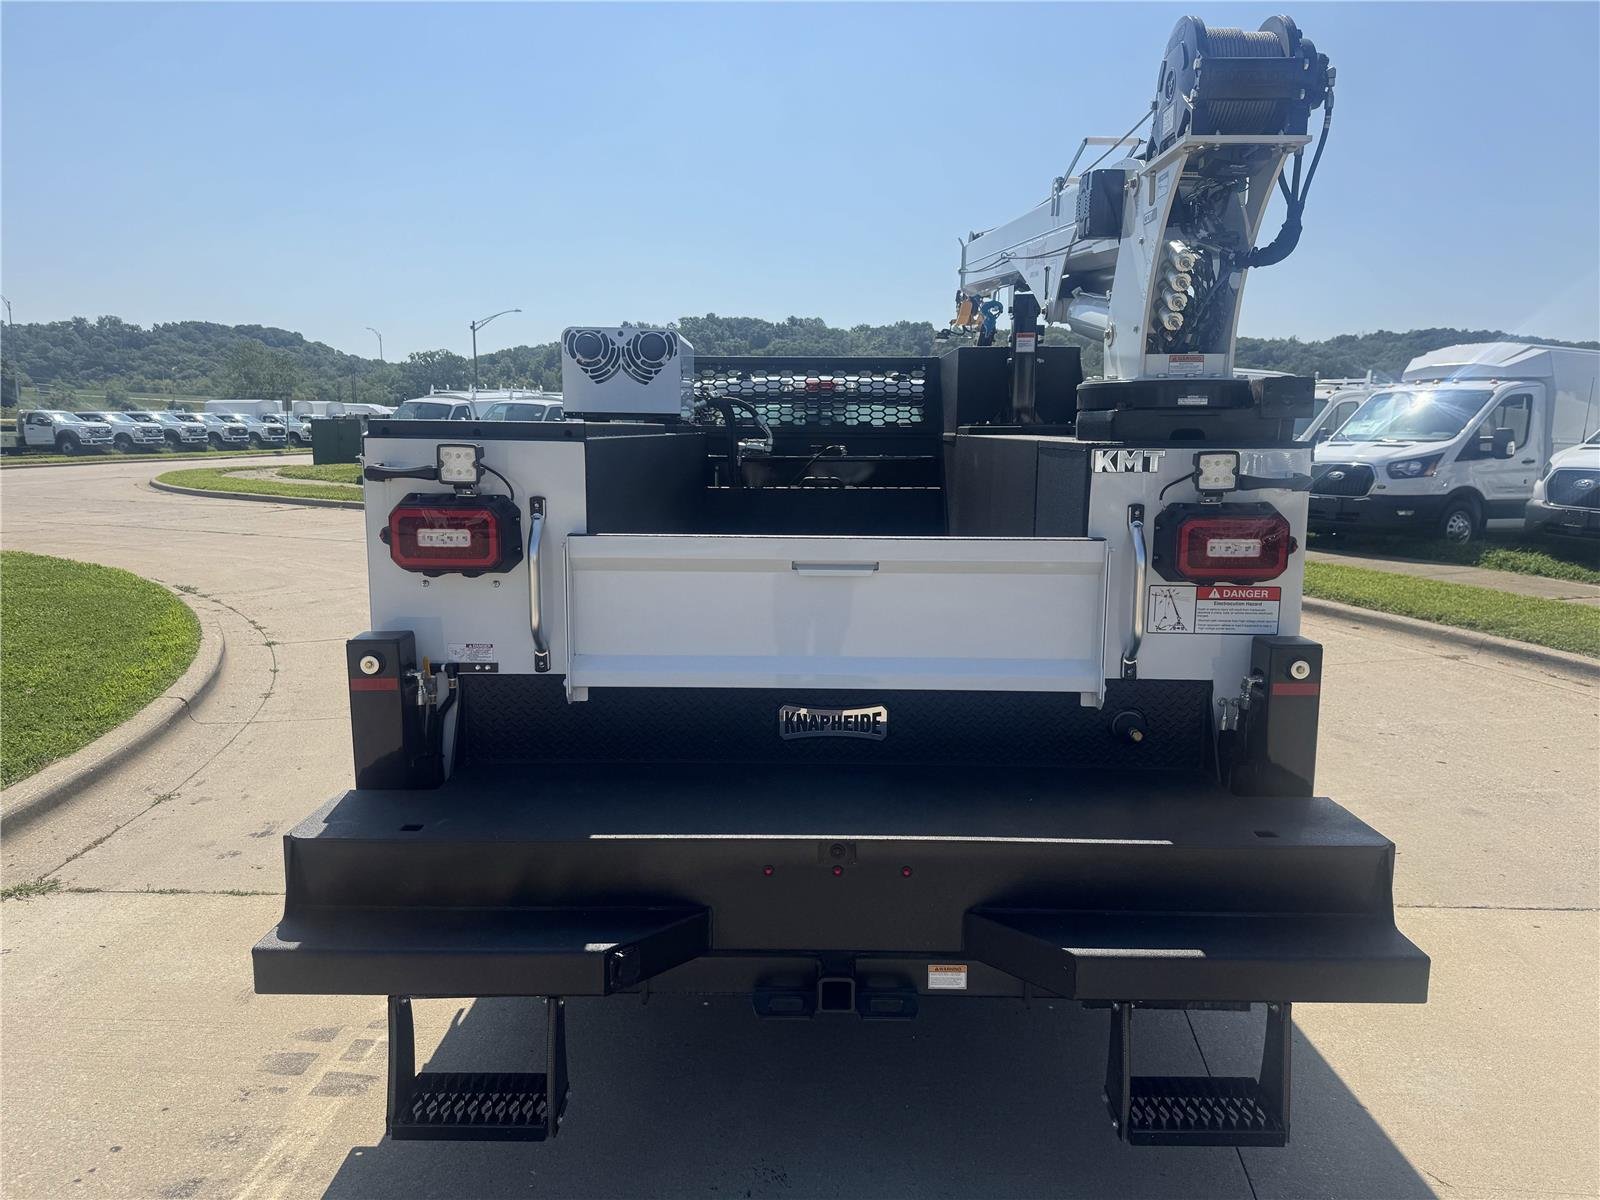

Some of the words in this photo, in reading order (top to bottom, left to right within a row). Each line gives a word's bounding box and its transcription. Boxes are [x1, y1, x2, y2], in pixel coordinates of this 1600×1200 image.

[1094, 451, 1166, 473] KMT
[1223, 589, 1269, 598] DANGER
[784, 710, 882, 735] KNAPHEIDE
